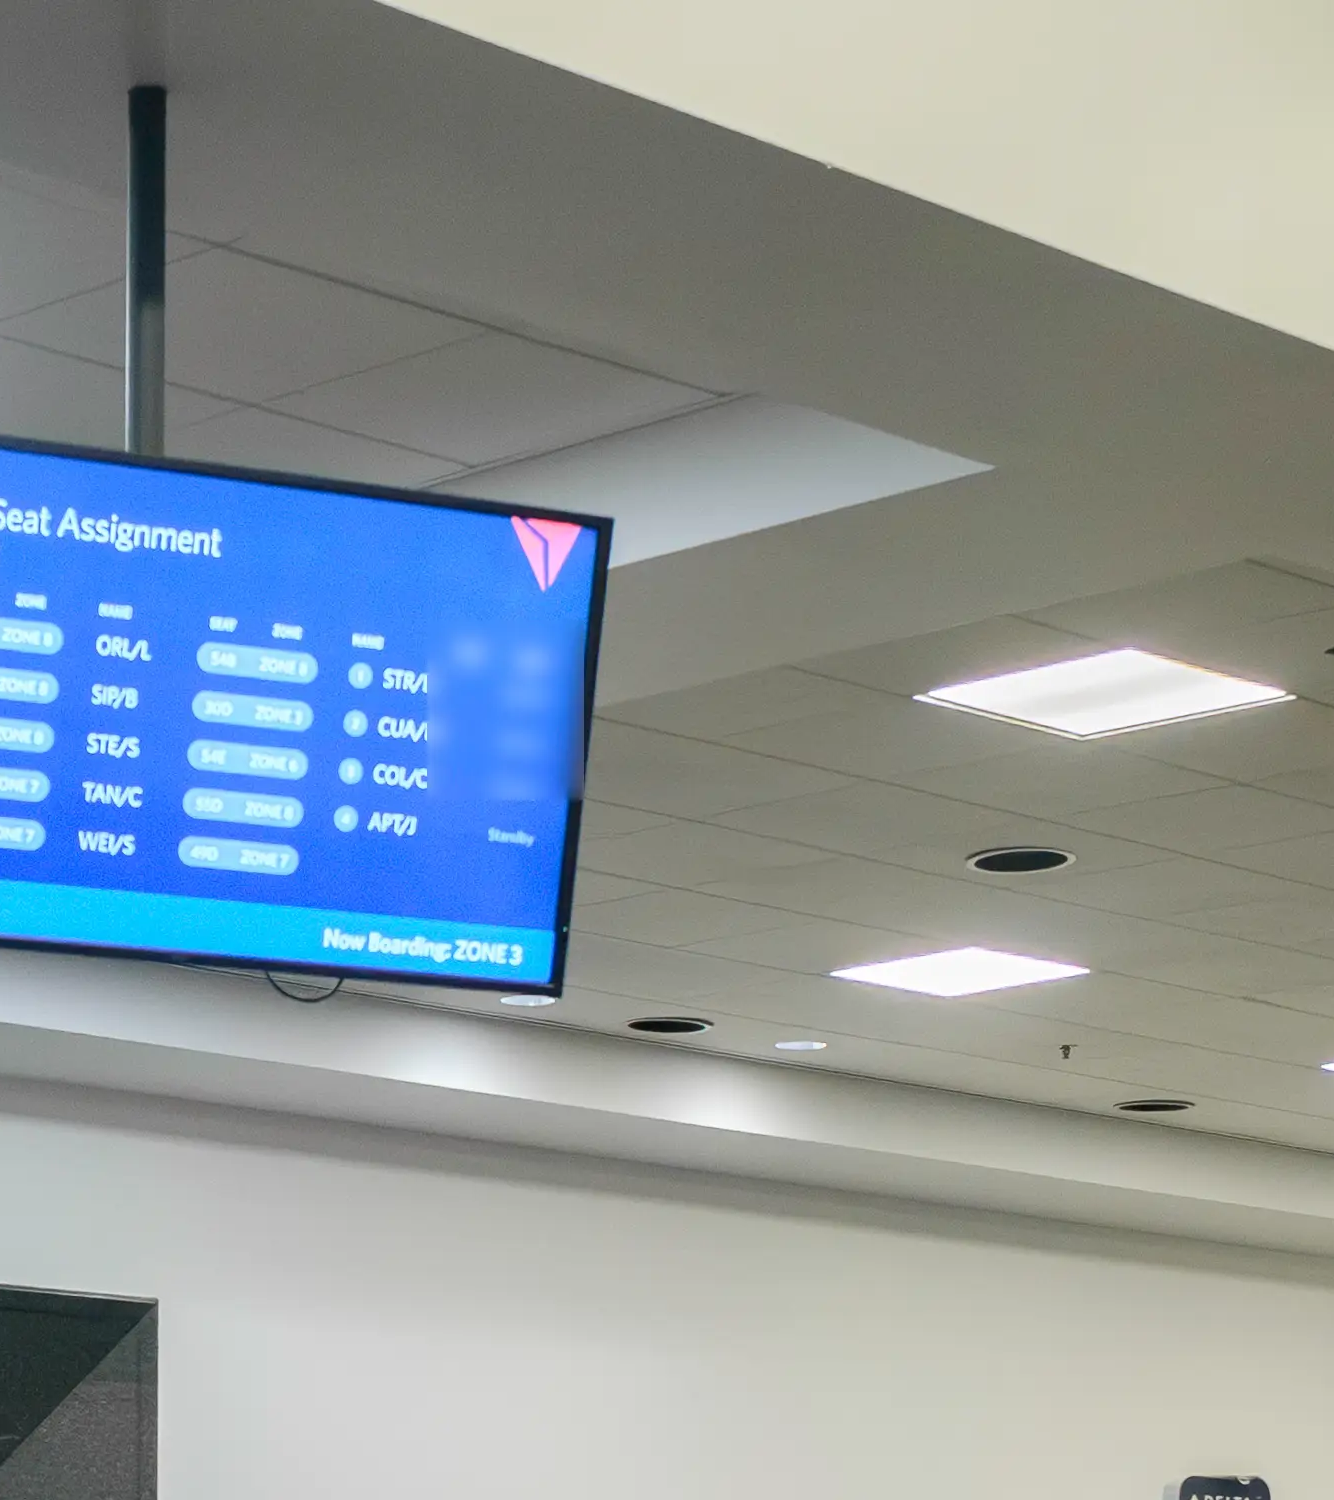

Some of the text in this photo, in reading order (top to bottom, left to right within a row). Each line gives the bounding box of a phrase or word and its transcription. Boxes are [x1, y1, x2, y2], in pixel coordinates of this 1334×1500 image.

[57, 508, 223, 558] Assignment
[2, 627, 40, 646] ZONE
[96, 634, 152, 662] ORL/L
[258, 656, 296, 675] ZONE
[91, 683, 139, 710] SIP/B
[254, 705, 293, 723] ZONE
[377, 716, 428, 742] CUA/
[86, 732, 141, 759] STE/S
[249, 752, 287, 771] ZONE
[82, 781, 144, 809] TAN/C
[244, 801, 283, 820] ZONE
[367, 811, 418, 837] APT/J
[78, 830, 136, 856] WEI/S
[239, 849, 279, 868] ZONE
[323, 927, 367, 952] Now
[453, 939, 509, 966] ZONE
[509, 944, 523, 967] 3
